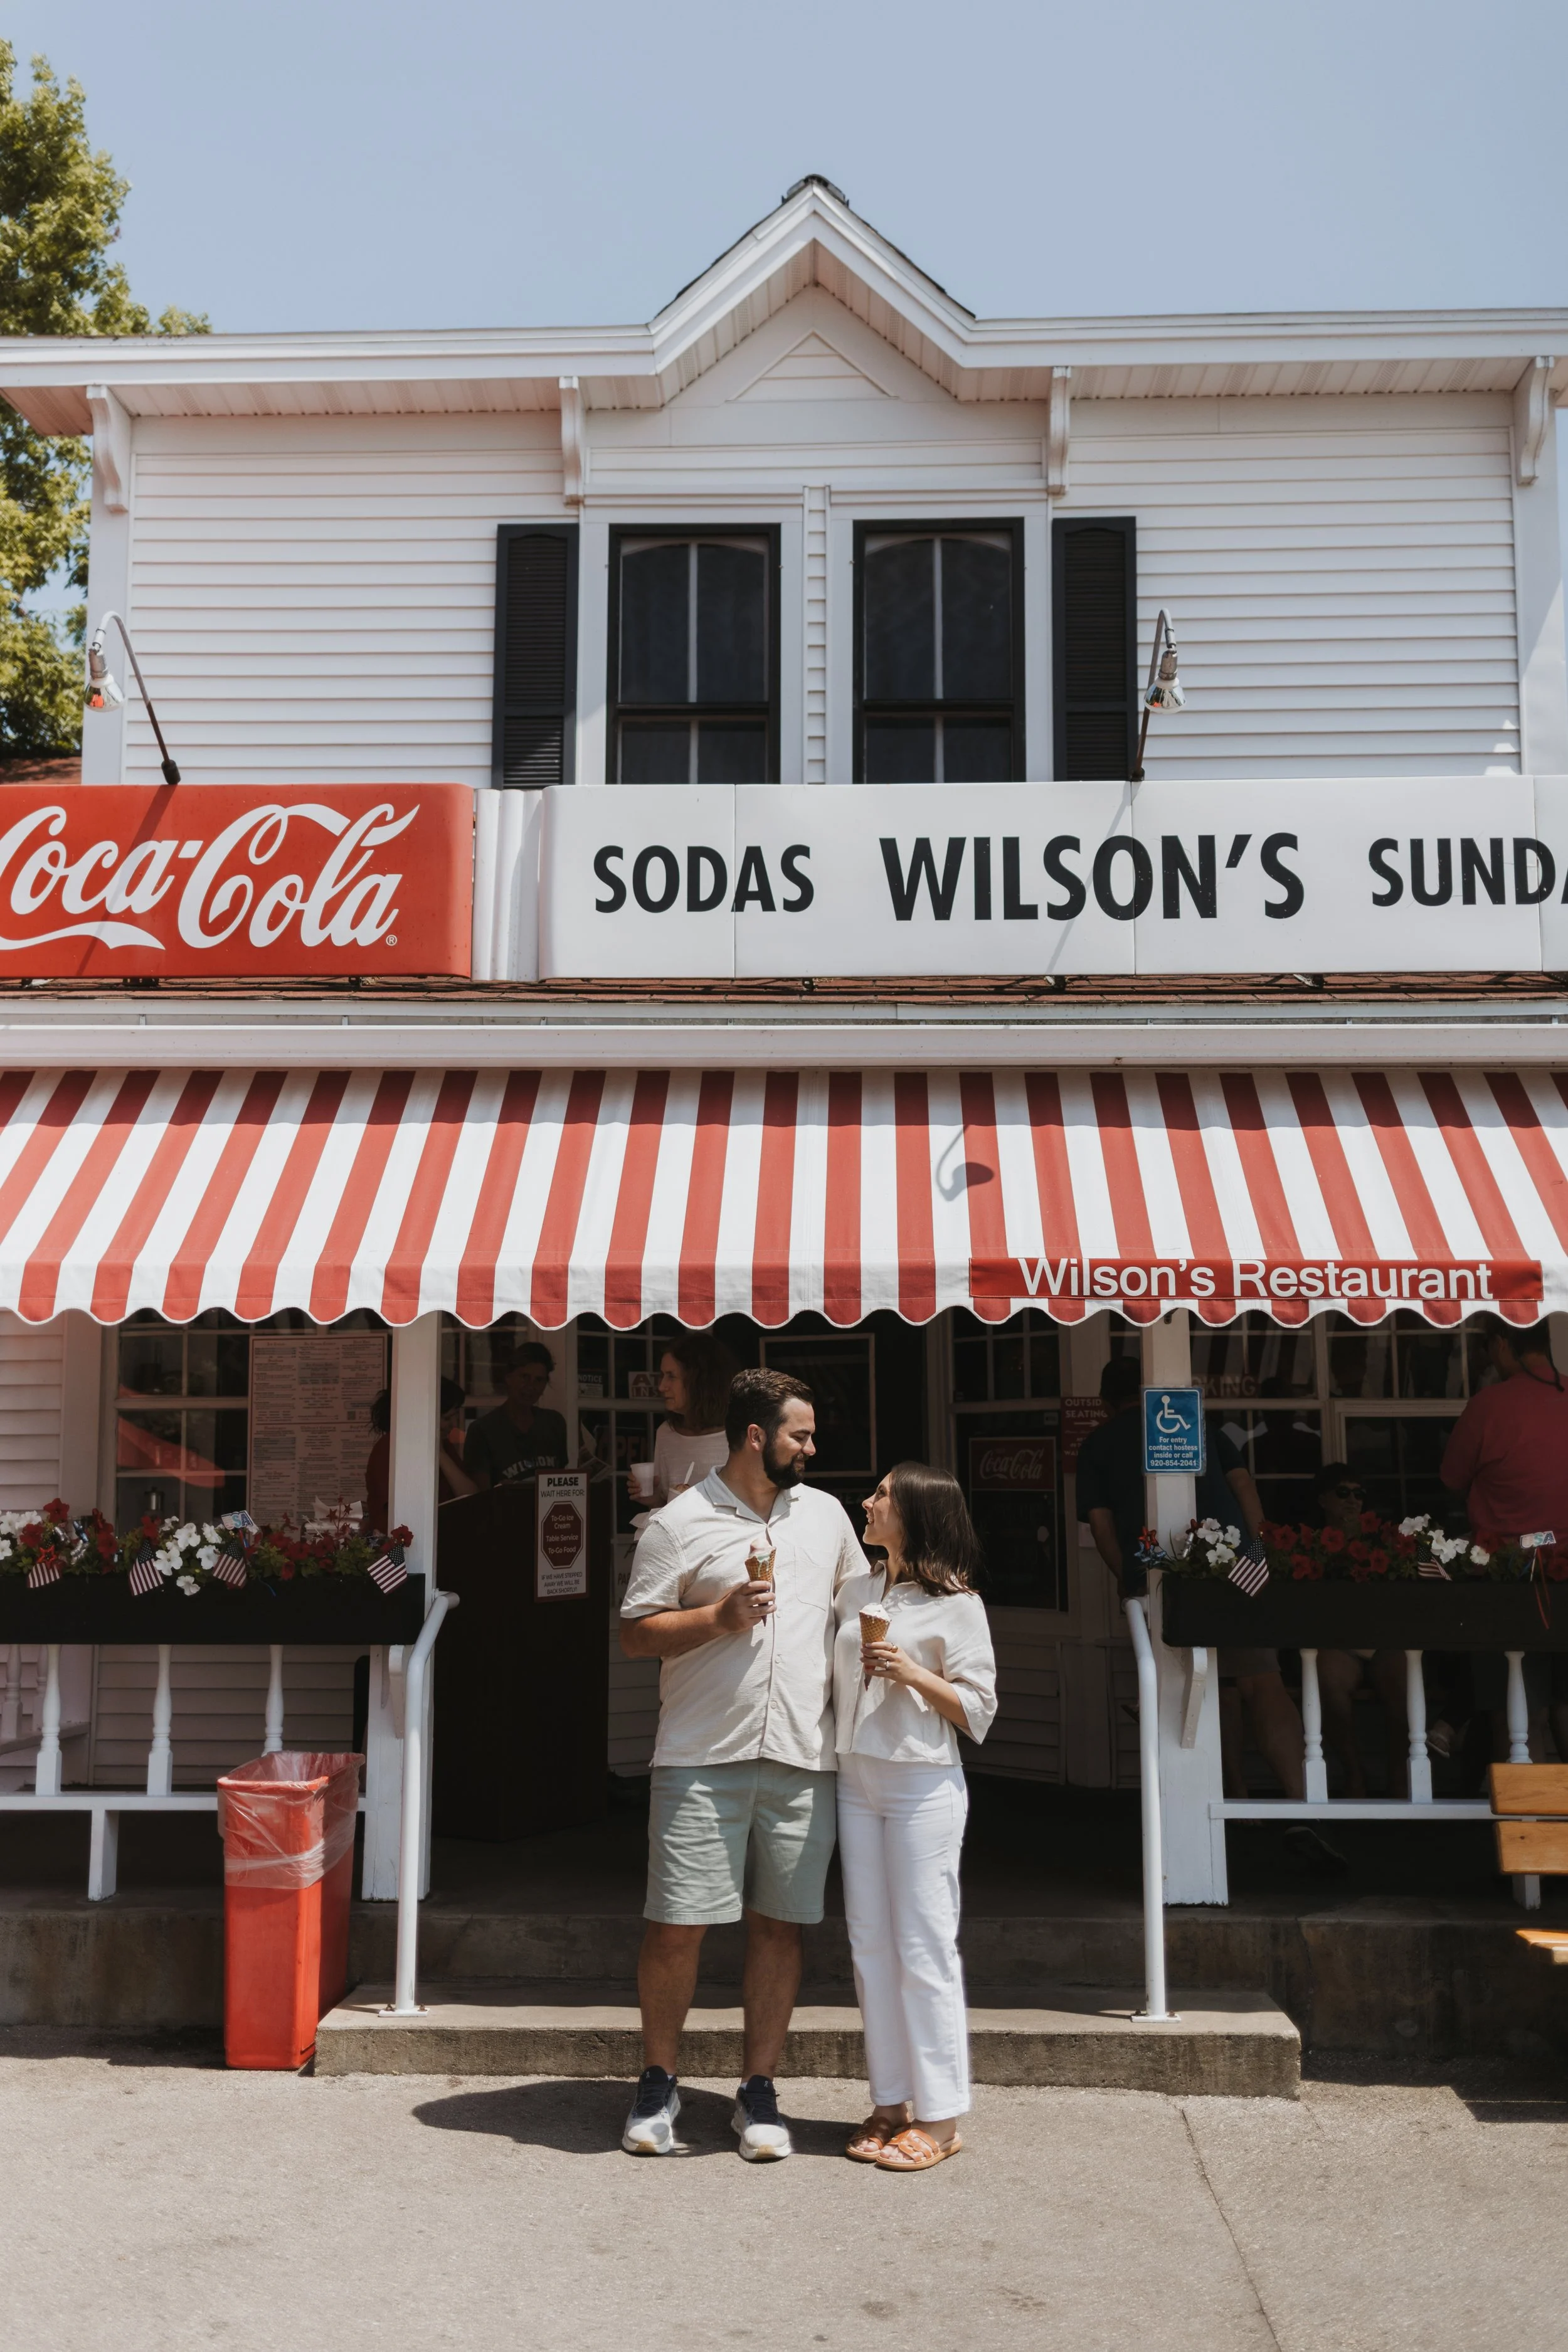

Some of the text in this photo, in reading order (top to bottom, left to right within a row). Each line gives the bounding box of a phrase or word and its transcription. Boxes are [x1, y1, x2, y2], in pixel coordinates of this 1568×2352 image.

[0, 803, 419, 950] Coca-Cola
[593, 832, 1568, 921] SODAS WILSON'S SUND
[1018, 1258, 1493, 1299] Wilson's Restaurant
[578, 1374, 603, 1383] NOTICE
[1065, 1409, 1108, 1418] SEATING
[980, 1448, 1044, 1480] Coca-Cola
[547, 1477, 579, 1487] PLEASE
[541, 1490, 555, 1498] WAIT
